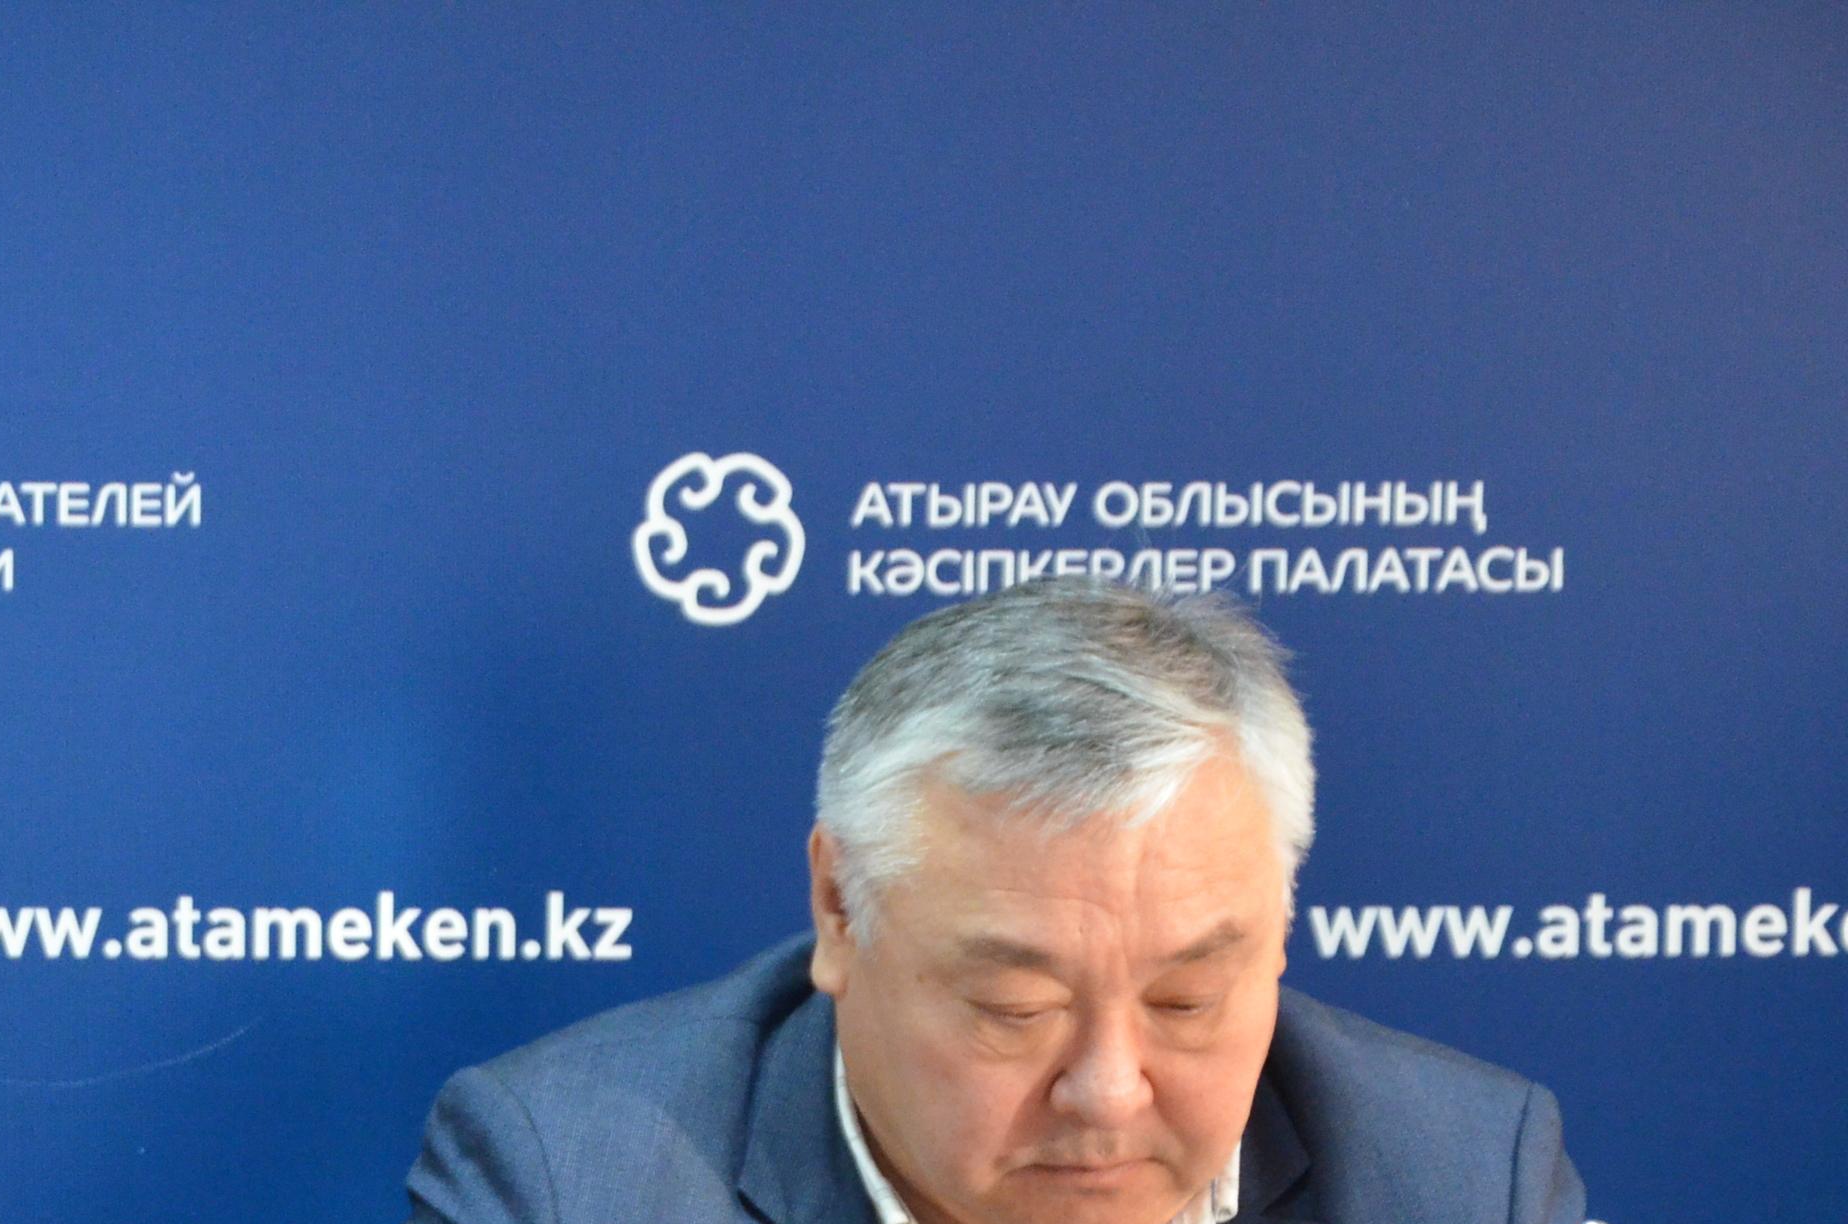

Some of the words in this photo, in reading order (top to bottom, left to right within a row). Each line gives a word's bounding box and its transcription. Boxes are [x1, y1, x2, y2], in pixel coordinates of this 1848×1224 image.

[850, 481, 1078, 529] АТЫРАУ
[1093, 480, 1489, 535] ОБЛЫСЫНЫҢ
[1249, 546, 1566, 595] ПАЛАТАСЫ
[1308, 887, 1848, 960] www.atamek
